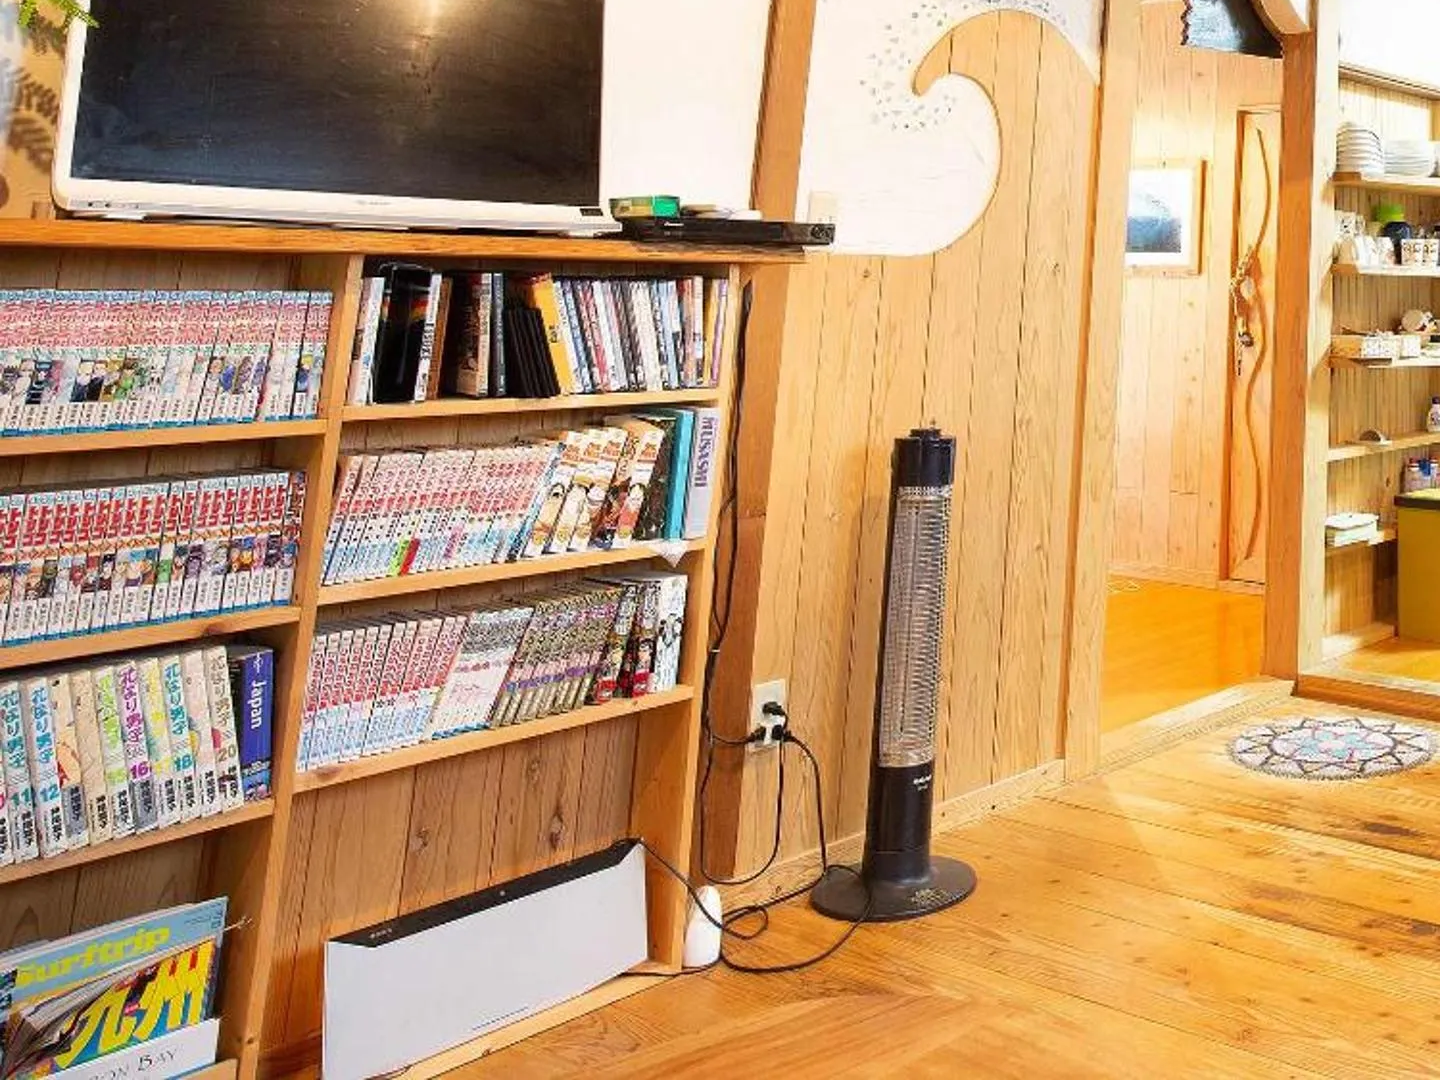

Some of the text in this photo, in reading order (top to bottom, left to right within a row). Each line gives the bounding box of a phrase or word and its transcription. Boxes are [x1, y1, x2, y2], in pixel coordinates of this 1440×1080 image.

[247, 680, 267, 730] Japan
[217, 745, 237, 762] 20
[130, 761, 149, 779] 16
[174, 755, 193, 771] 18
[40, 784, 60, 802] 12
